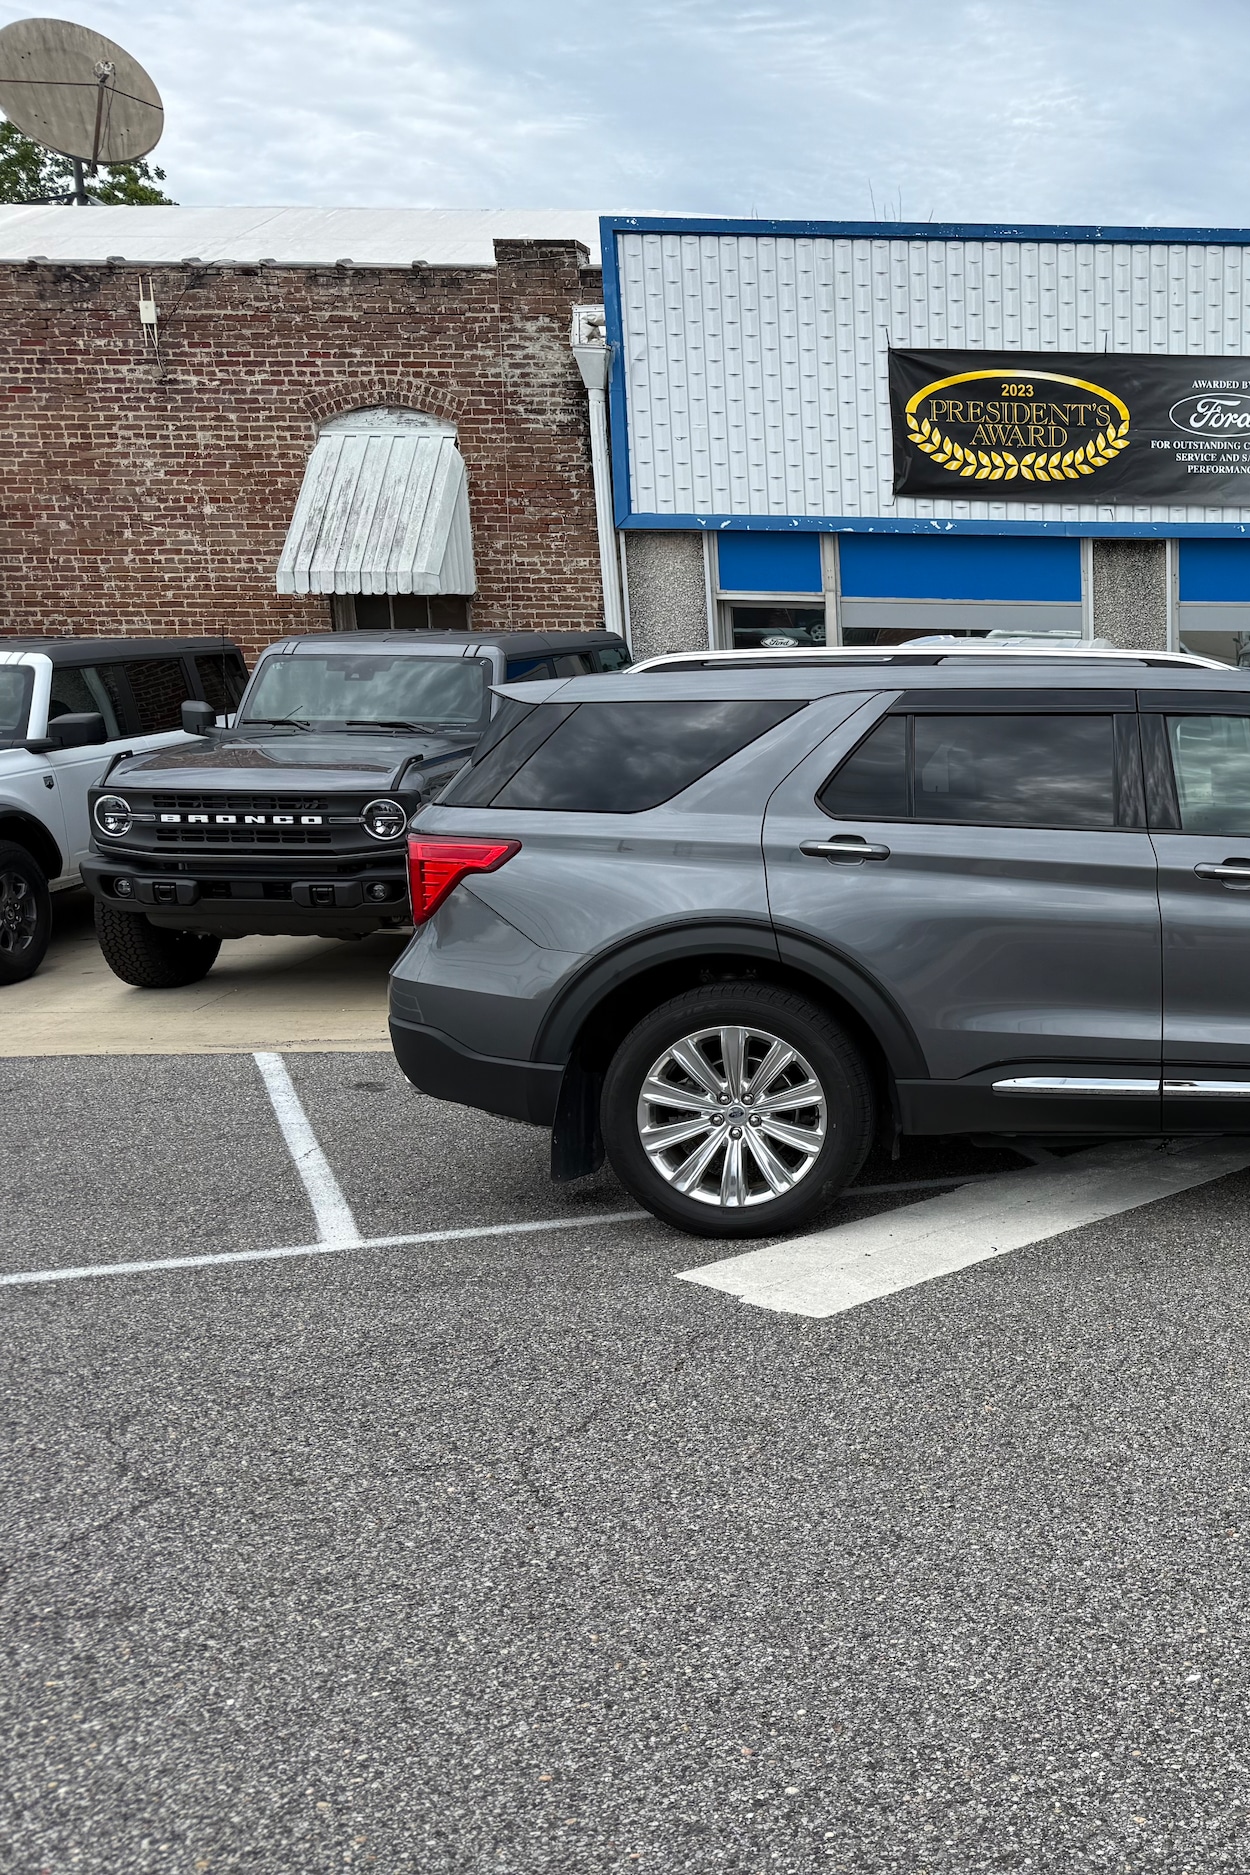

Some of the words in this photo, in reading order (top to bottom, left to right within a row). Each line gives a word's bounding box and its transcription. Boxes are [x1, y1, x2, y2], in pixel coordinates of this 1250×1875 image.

[1191, 380, 1240, 389] AWARDED
[1001, 383, 1035, 398] 2023
[928, 399, 1111, 427] PRESIDENT'S
[969, 424, 1068, 448] AWARD
[1150, 440, 1171, 449] FOR
[1173, 440, 1241, 450] OUTSTANDING
[1175, 453, 1217, 462] SERVICE
[1219, 454, 1240, 463] AND
[160, 814, 323, 825] BRONCO
